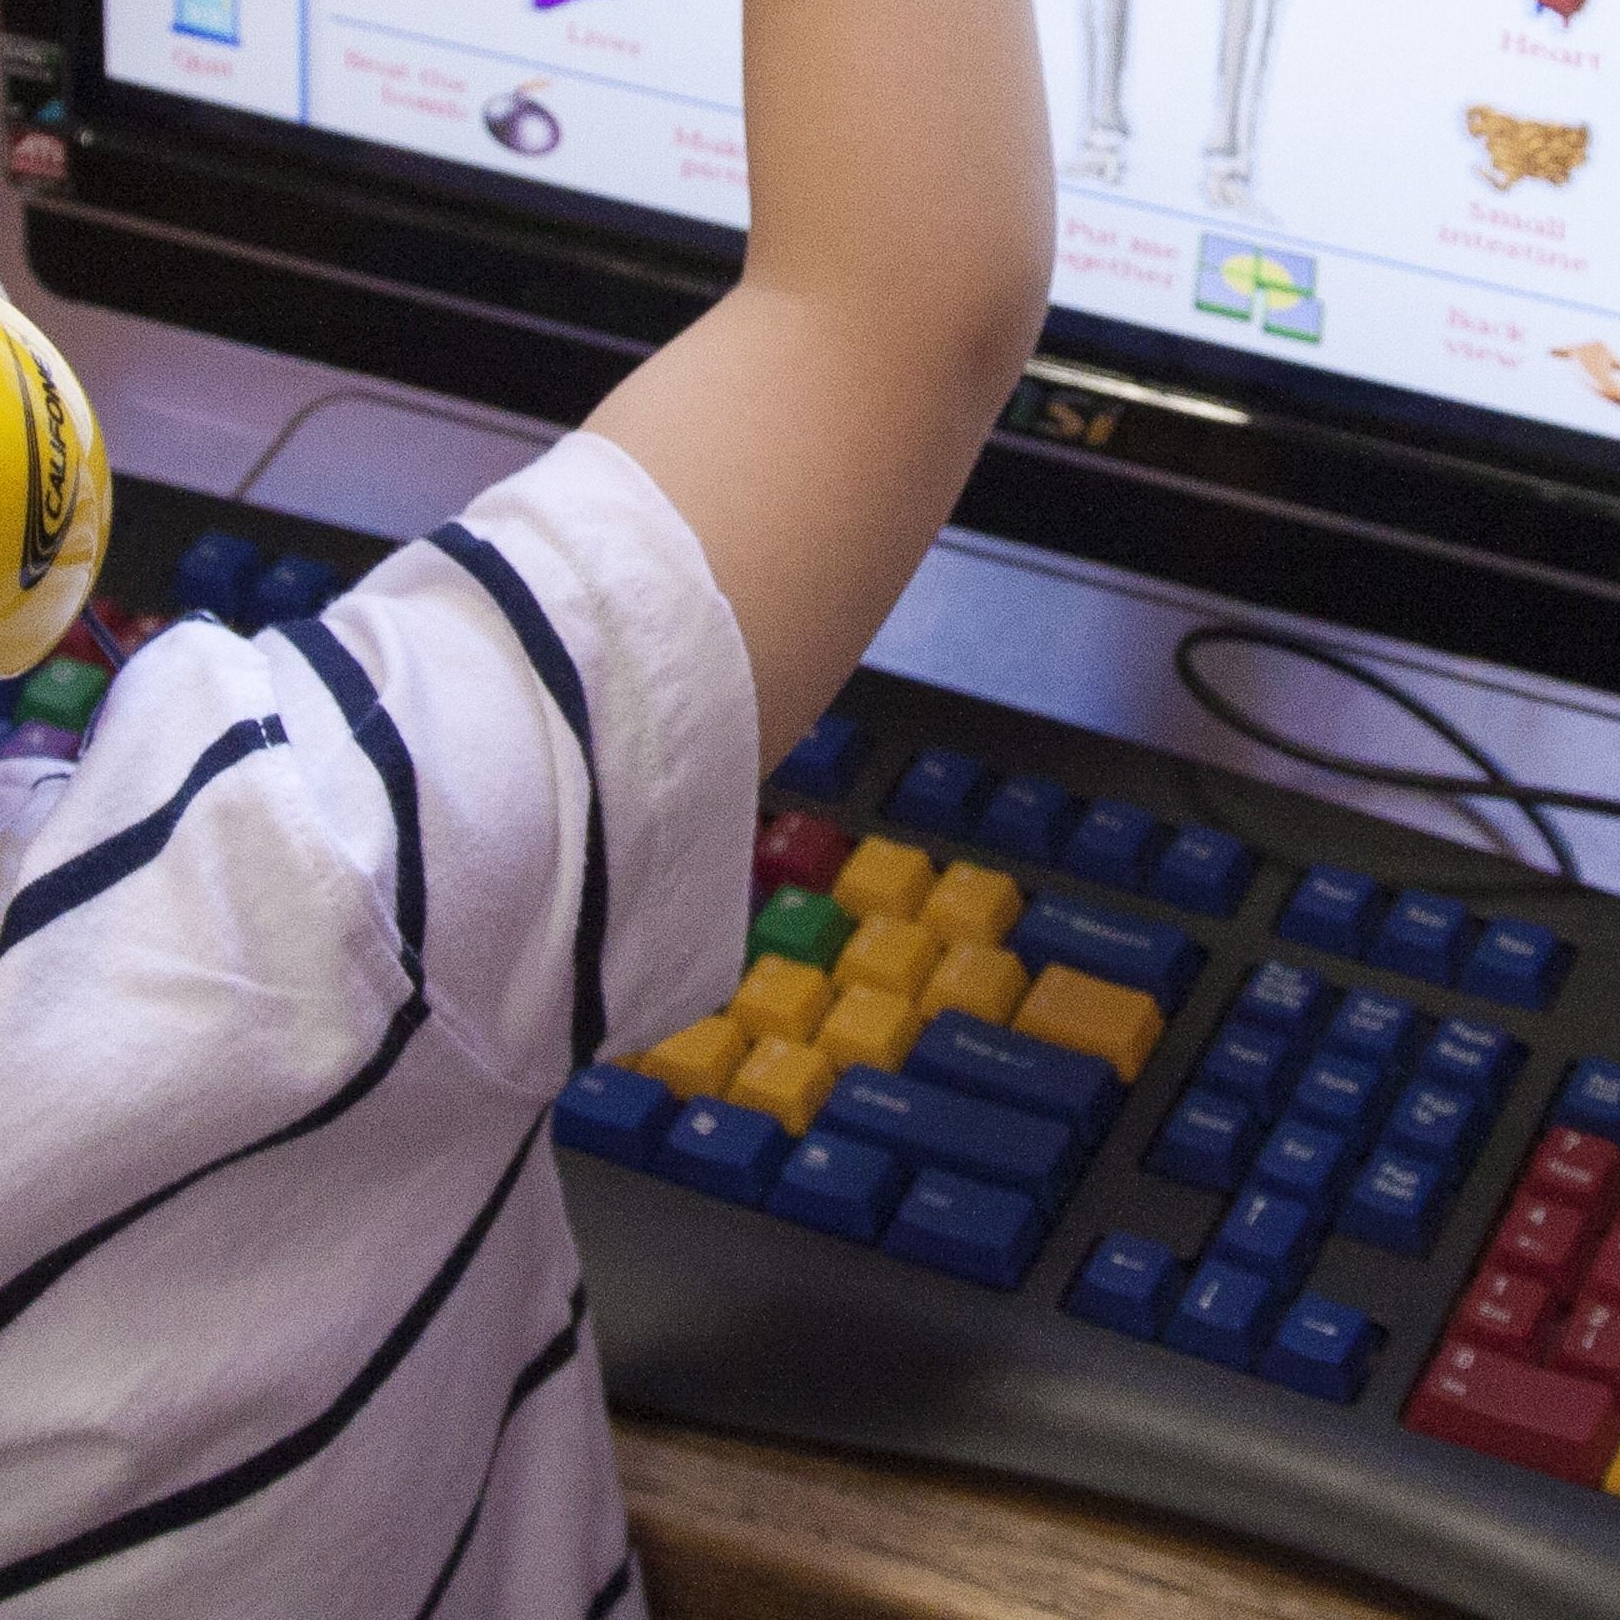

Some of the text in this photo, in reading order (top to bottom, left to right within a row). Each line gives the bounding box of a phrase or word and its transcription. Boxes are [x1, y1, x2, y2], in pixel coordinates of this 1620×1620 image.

[1498, 28, 1604, 70] Heart
[1468, 200, 1568, 242] Small
[1437, 224, 1590, 273] intestine
[1059, 249, 1178, 293] ogether
[1446, 305, 1530, 346] Back
